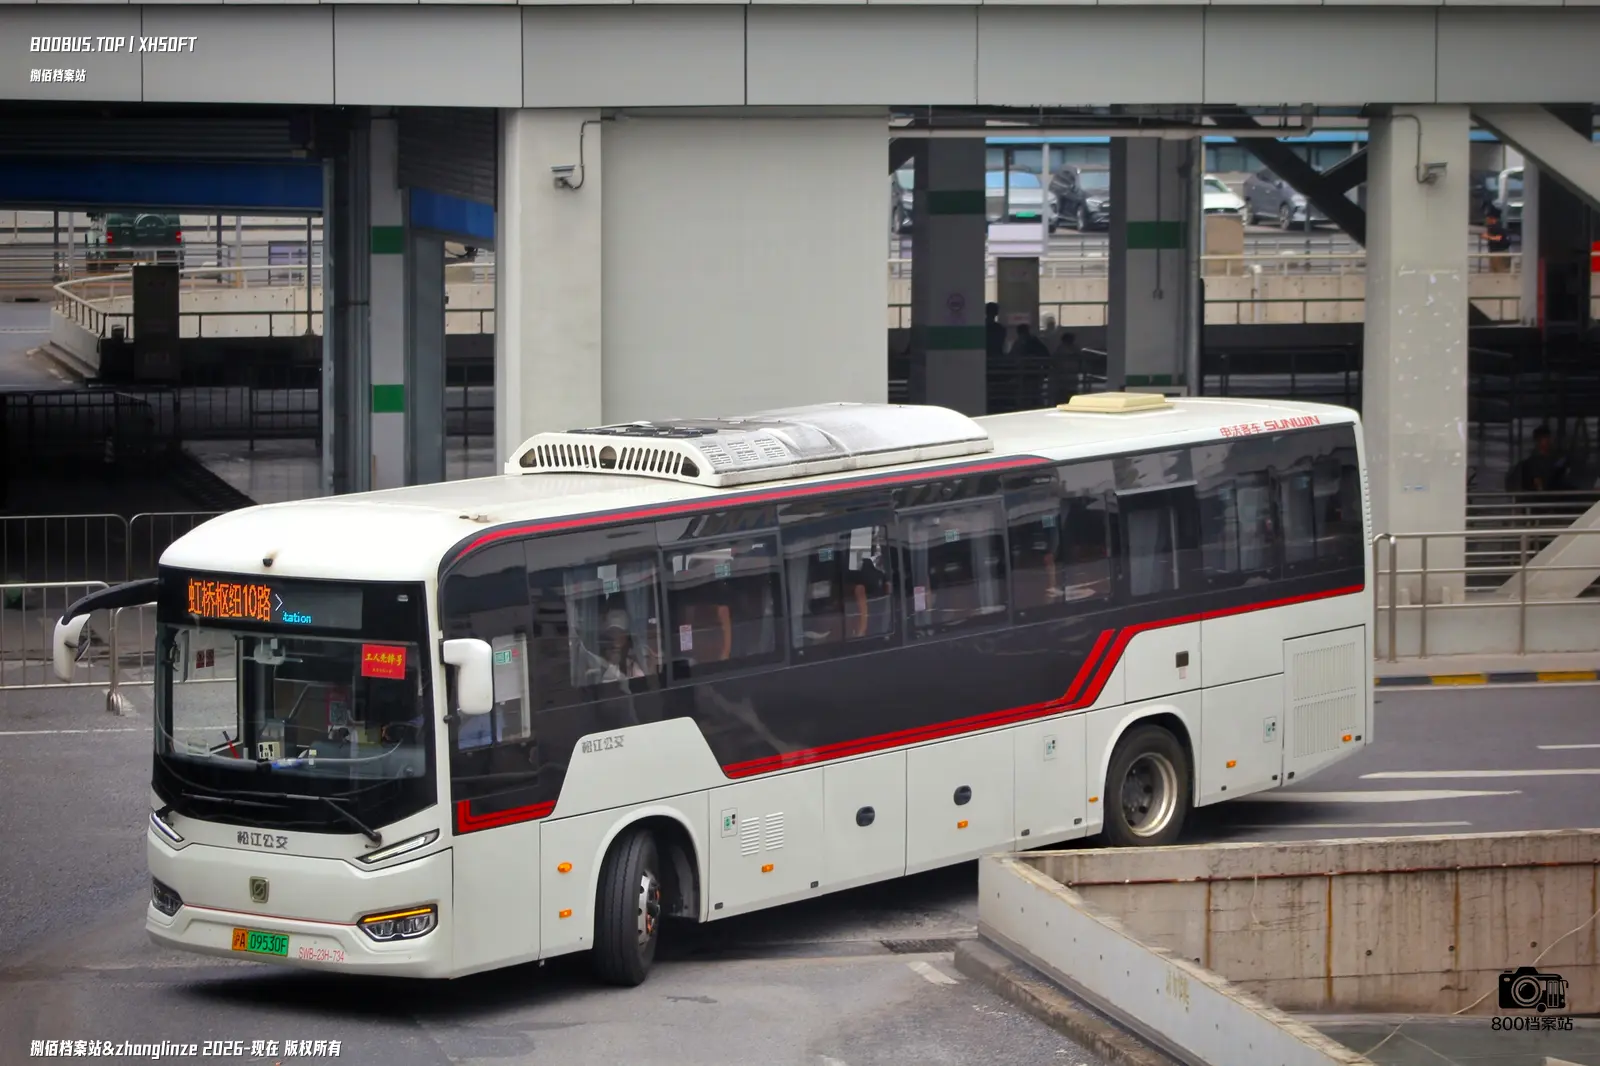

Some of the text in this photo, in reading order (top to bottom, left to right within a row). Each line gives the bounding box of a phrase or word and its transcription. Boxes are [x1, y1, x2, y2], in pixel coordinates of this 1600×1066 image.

[1264, 415, 1320, 430] SUNWIN
[188, 578, 271, 622] 虹桥枢纽10路
[282, 611, 312, 624] tation
[582, 735, 625, 753] 松江公交
[237, 831, 288, 849] 松江公交
[298, 947, 344, 961] SWB-23H-734
